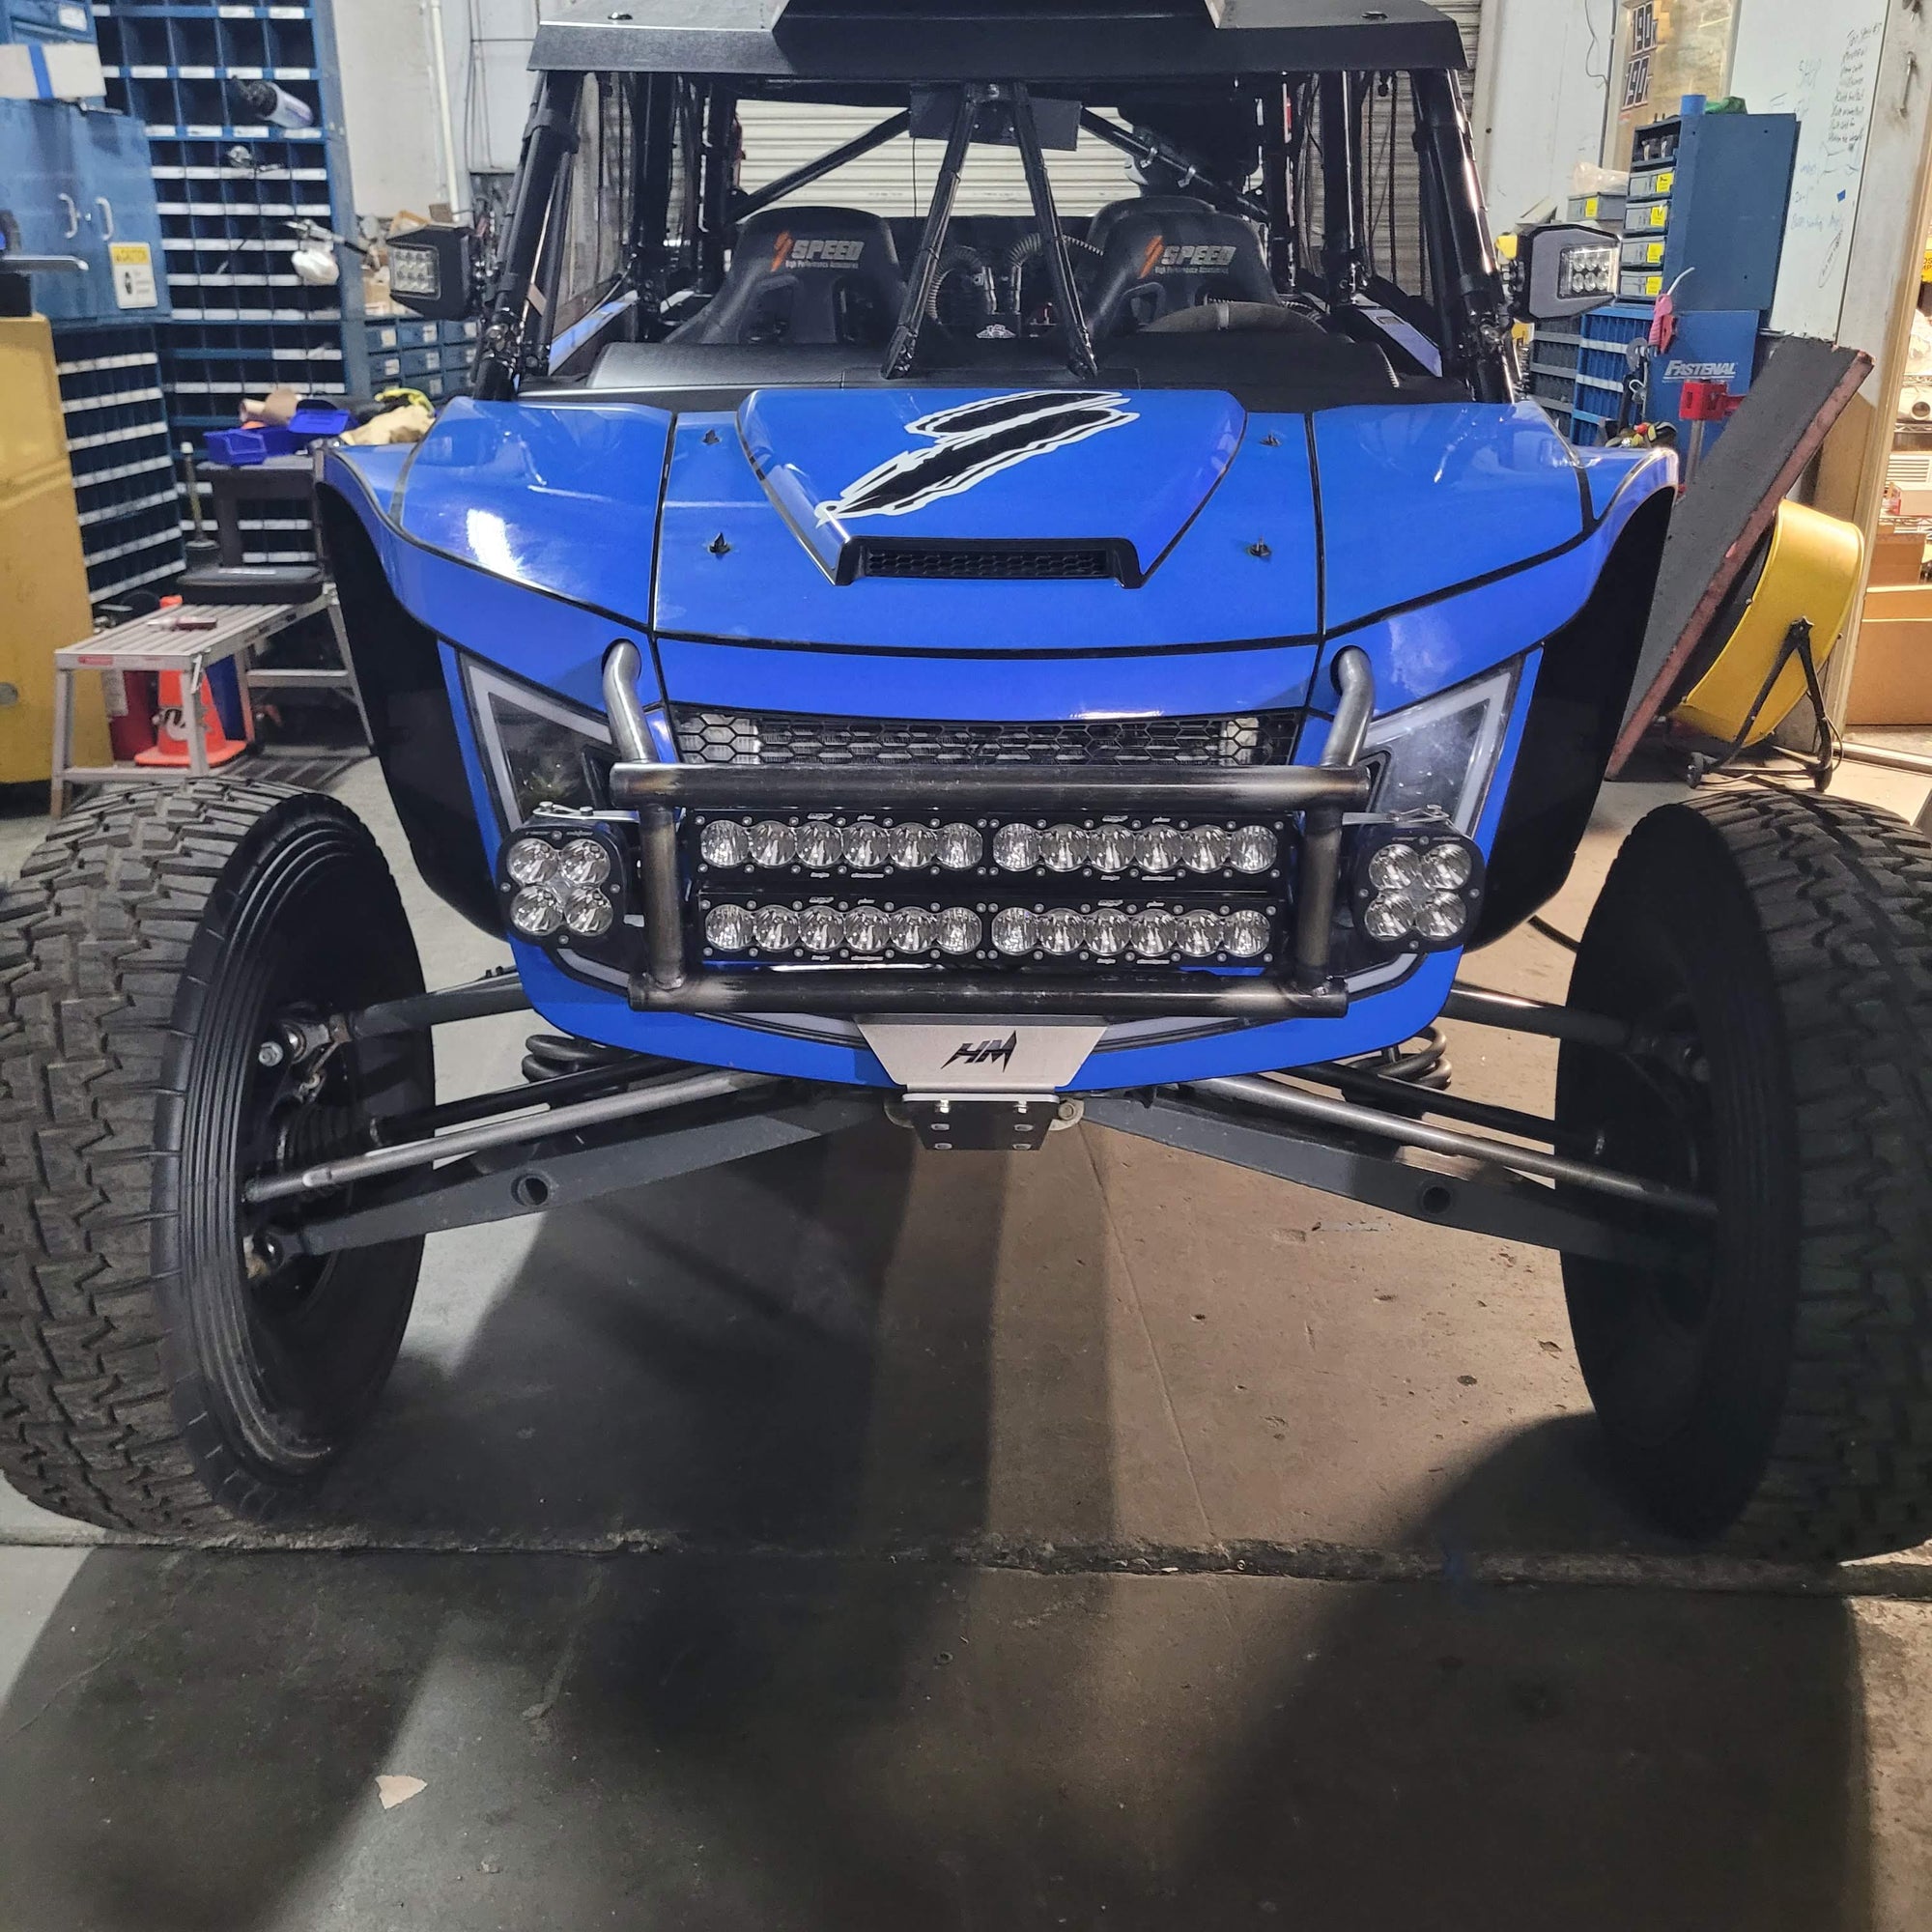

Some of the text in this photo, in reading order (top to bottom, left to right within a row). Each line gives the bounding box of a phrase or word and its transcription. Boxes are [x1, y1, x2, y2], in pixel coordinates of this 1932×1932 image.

[792, 240, 865, 260] SPEED
[1161, 245, 1236, 265] SPEED
[1664, 359, 1736, 376] FASTENAL
